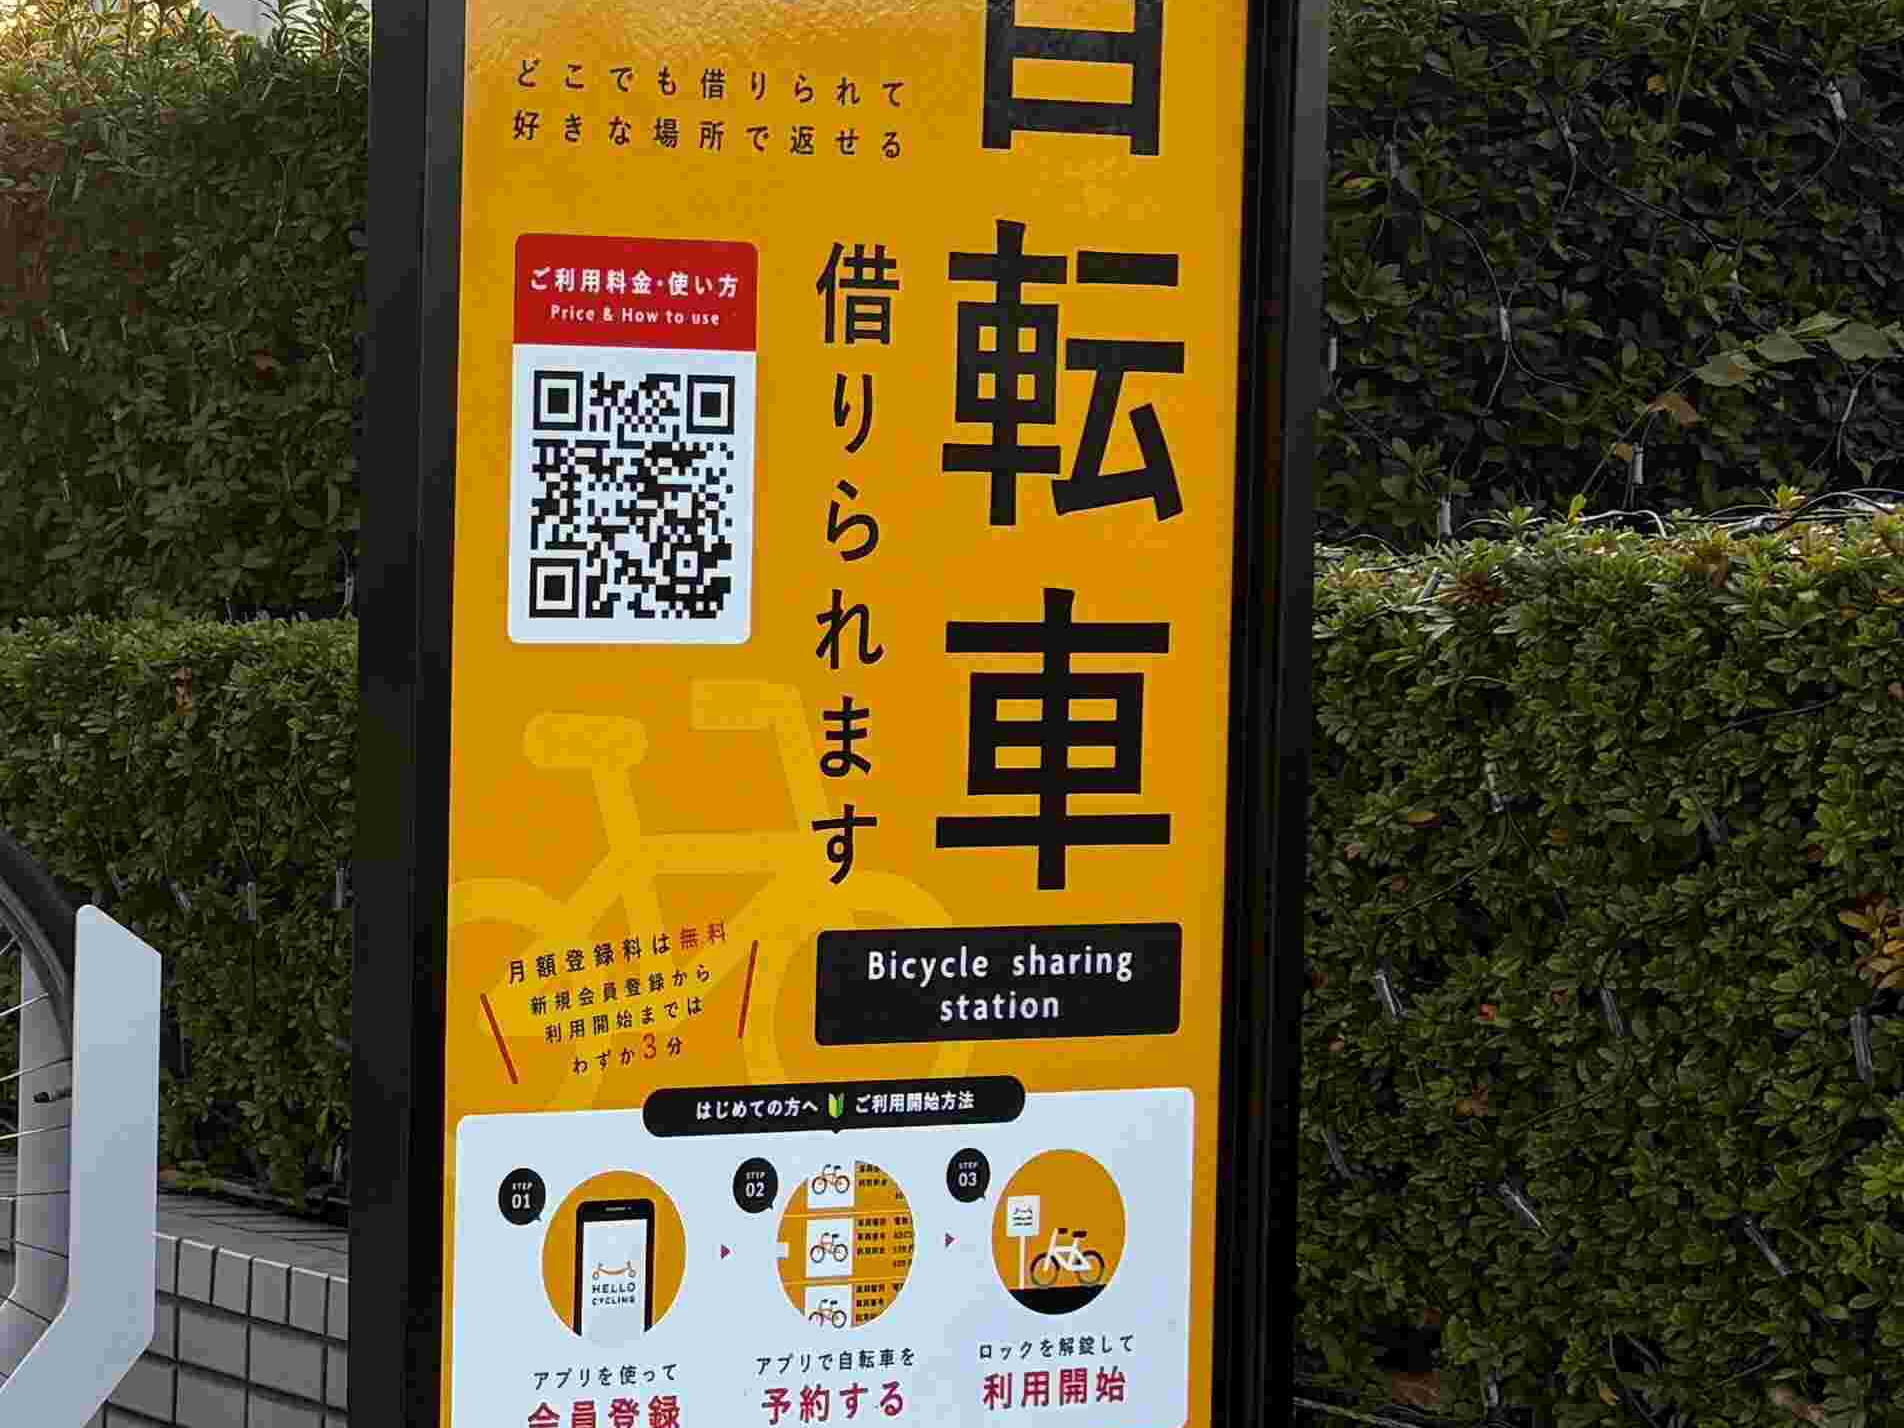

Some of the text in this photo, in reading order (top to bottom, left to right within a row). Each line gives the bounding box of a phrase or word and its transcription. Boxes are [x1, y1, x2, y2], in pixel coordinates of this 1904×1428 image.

[517, 58, 905, 108] どこでも借りられて
[512, 108, 902, 159] 好きな場所で返せる
[530, 267, 739, 298] ご利用料金・使い方
[550, 304, 721, 326] Price & How to use
[811, 241, 901, 885] 借りられます
[509, 922, 728, 984] 月額登録料は無料
[866, 945, 1135, 985] Bicycle sharing
[529, 963, 713, 1016] 新規会員登録から
[544, 996, 705, 1044] 利用開始までは
[938, 990, 1061, 1023] station
[695, 1090, 976, 1121] はじめての方へ ご利用開始方法
[745, 1181, 766, 1198] 02
[958, 1171, 977, 1187] 03
[511, 1193, 531, 1210] 01
[591, 1281, 636, 1295] HELLO
[591, 1294, 636, 1307] CYCLING
[756, 1346, 916, 1375] アプリで自転車を
[979, 1333, 1135, 1361] ロックを解錠して
[533, 1362, 678, 1391] アプリを使って
[982, 1367, 1128, 1412] 利用開始
[760, 1380, 906, 1428] 予約する
